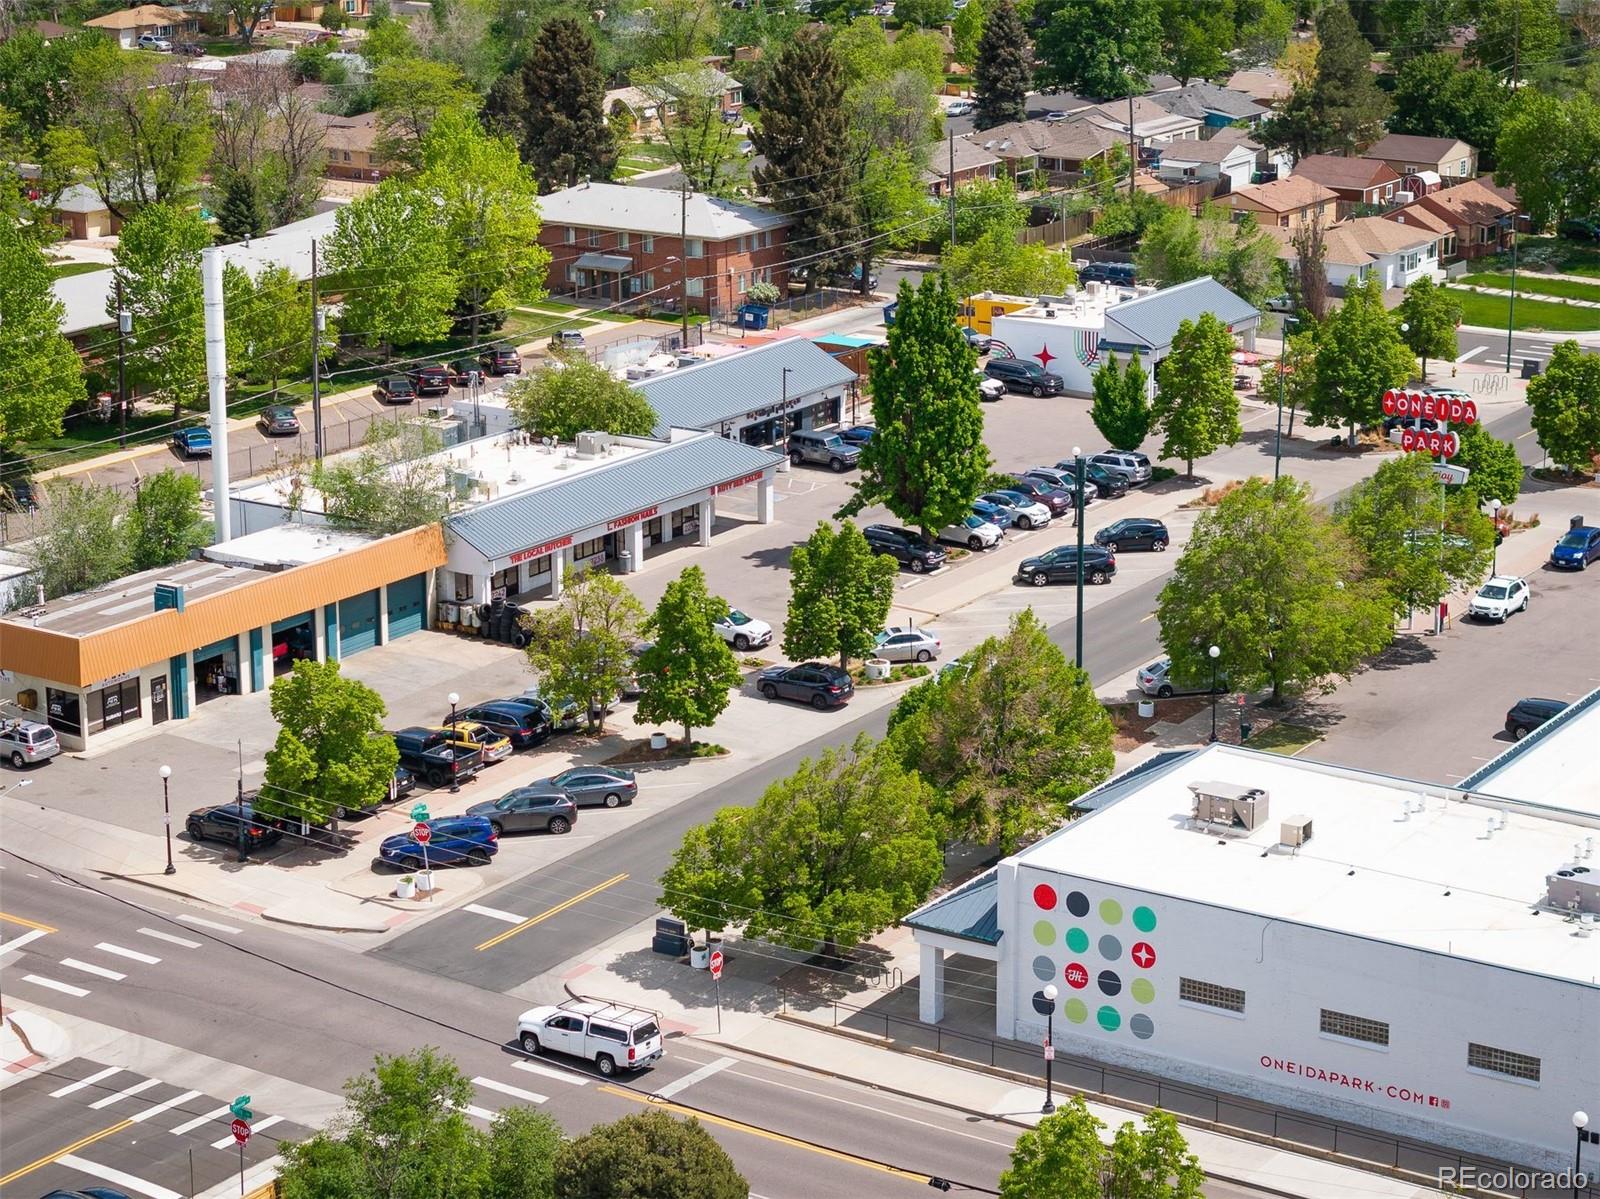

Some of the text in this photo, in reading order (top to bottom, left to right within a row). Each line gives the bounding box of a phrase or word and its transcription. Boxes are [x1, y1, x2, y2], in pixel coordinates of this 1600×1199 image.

[1397, 399, 1474, 419] ONEIDA
[1403, 434, 1454, 453] PARK
[613, 514, 639, 530] FASHION
[640, 505, 659, 521] NAILS
[509, 555, 522, 564] THE
[523, 545, 544, 561] LOCAL
[414, 828, 429, 837] STOP
[232, 1123, 249, 1137] STOP
